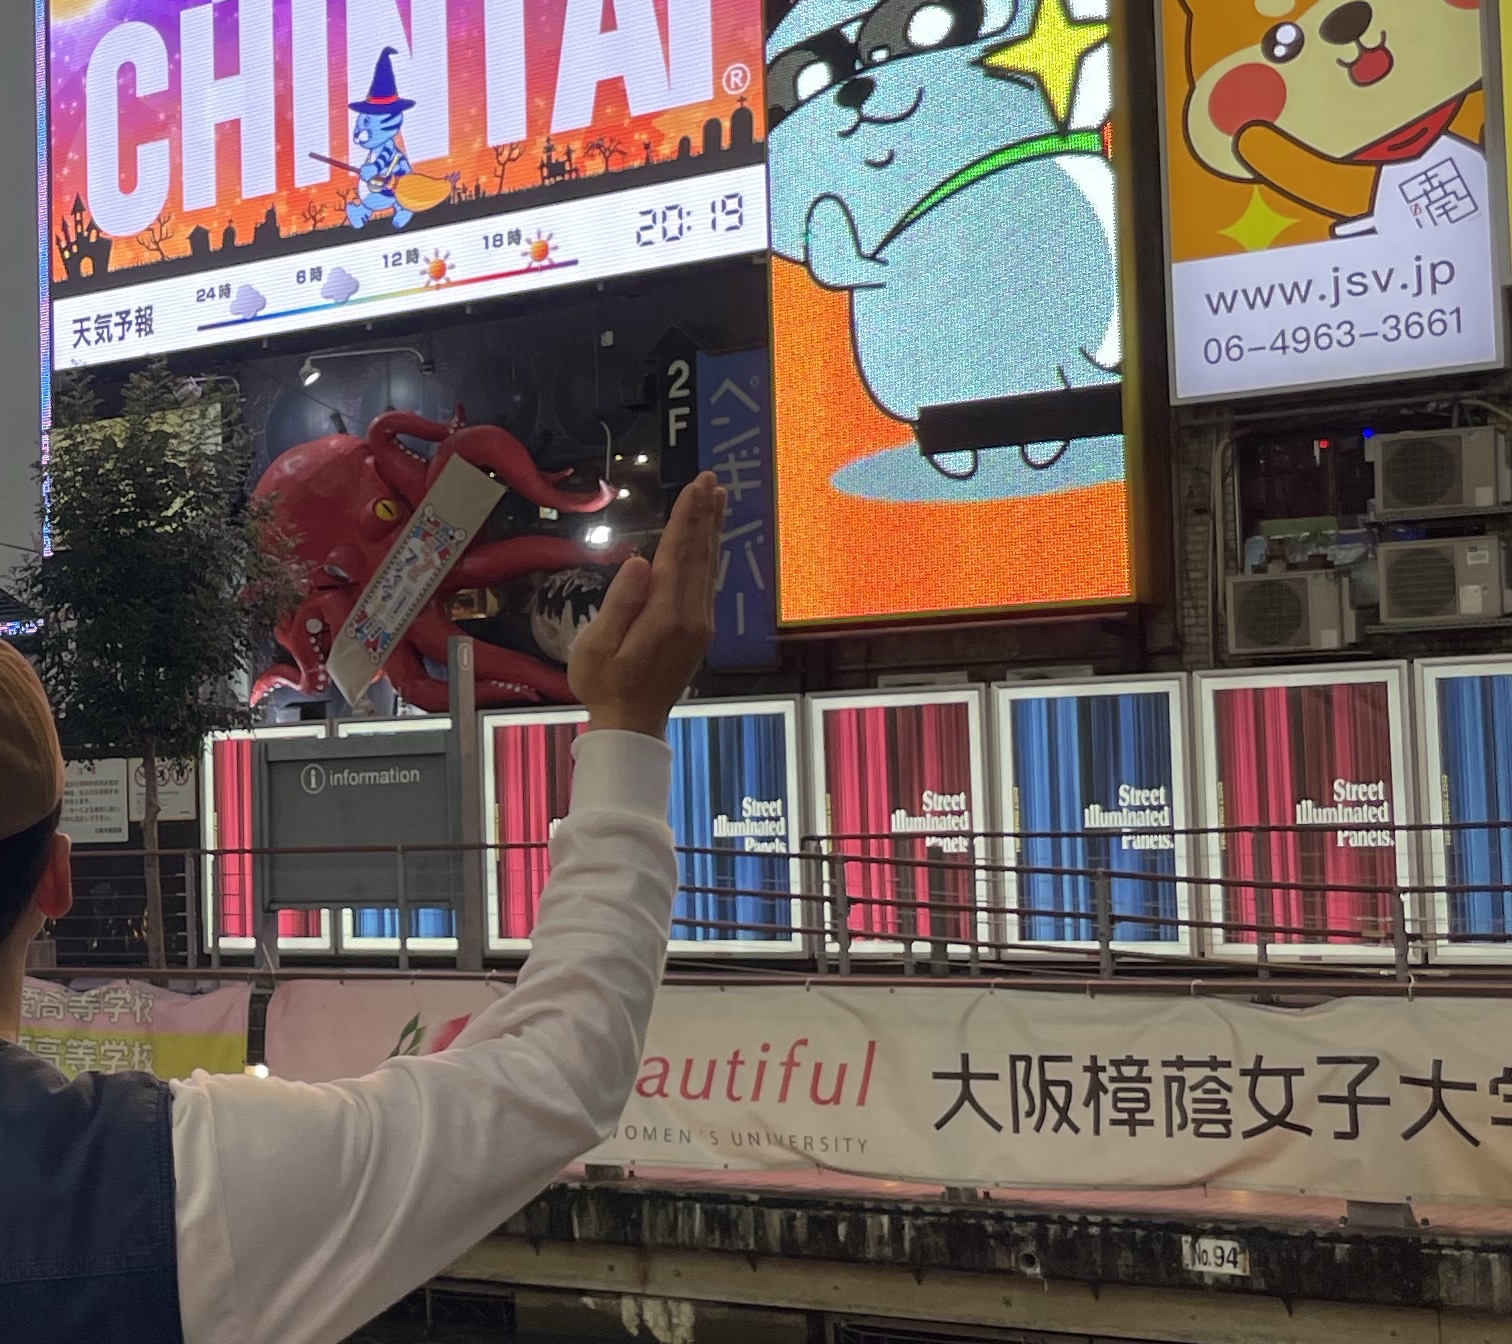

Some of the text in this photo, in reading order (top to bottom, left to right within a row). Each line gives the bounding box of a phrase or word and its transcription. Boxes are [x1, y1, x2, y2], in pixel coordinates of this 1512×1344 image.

[635, 192, 745, 249] 20:19
[196, 228, 522, 304] 24時 6時 12時 18時
[1205, 254, 1458, 317] www.jsv.jp
[72, 304, 156, 350] 天気予報
[1202, 307, 1464, 366] 06-4963-3661
[710, 374, 765, 637] ペンギンバー
[329, 766, 420, 787] information
[1118, 783, 1166, 807] Street
[1333, 777, 1385, 803] Street
[741, 796, 784, 818] Street
[922, 790, 967, 812] Street
[636, 1037, 878, 1108] autiful
[732, 1131, 869, 1155] UNIVERSITY
[1193, 1243, 1239, 1273] No.94
